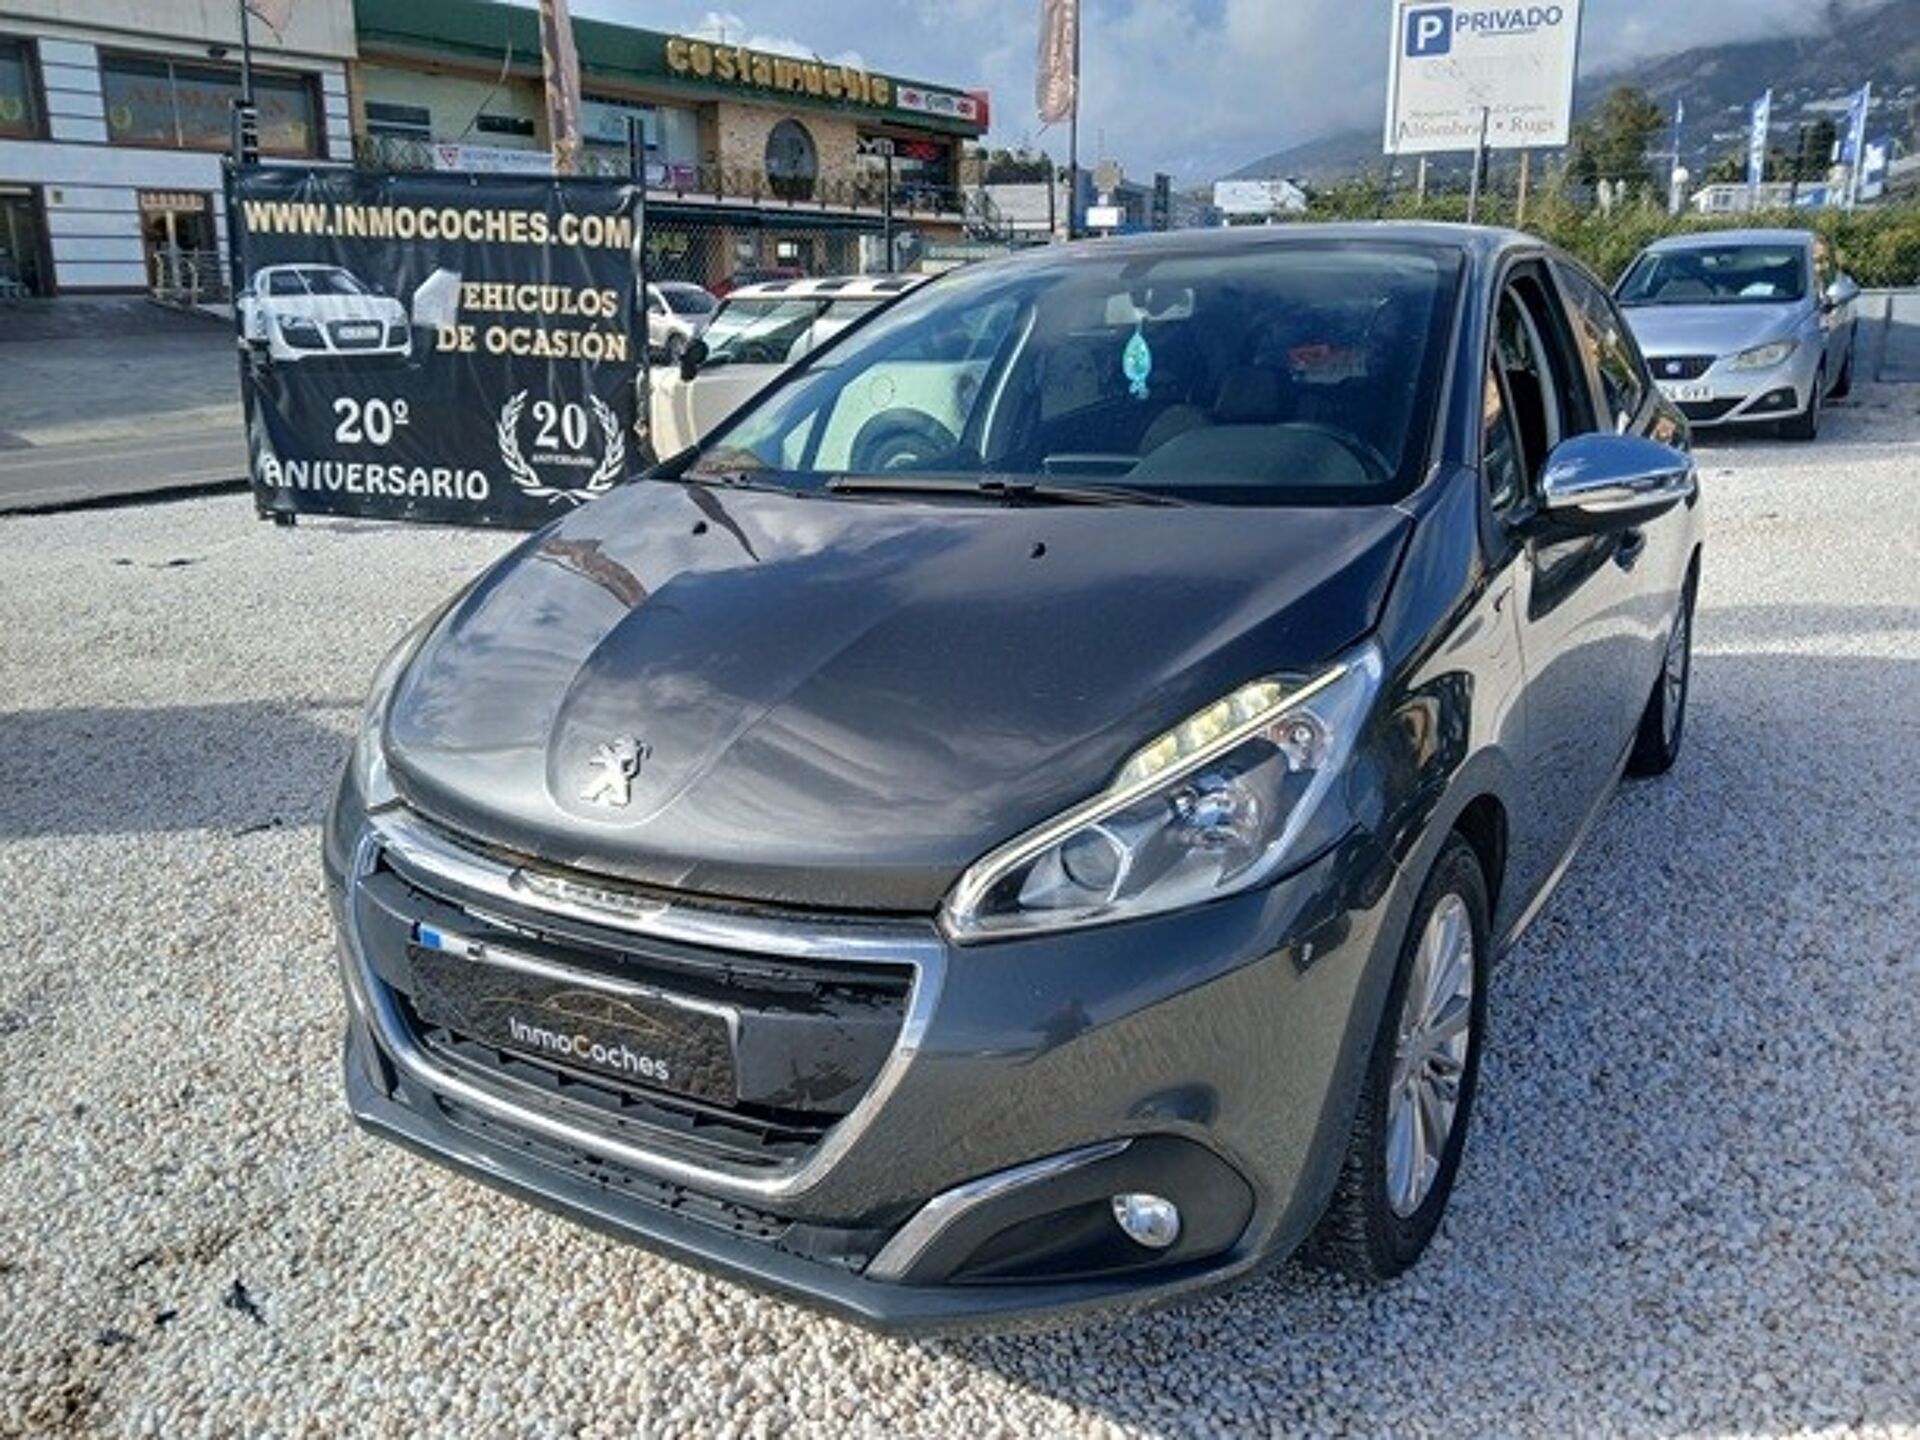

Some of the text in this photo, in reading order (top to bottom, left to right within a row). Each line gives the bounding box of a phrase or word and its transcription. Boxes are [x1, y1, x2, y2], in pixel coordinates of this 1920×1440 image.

[1455, 6, 1563, 32] PRIVADO
[244, 201, 632, 249] WWW.INMOCOCHES.COM
[436, 323, 628, 361] DE OCASIÓN
[532, 401, 589, 449] 20
[264, 459, 490, 499] ANIVERSARIO
[509, 1016, 669, 1080] InmoCoches
